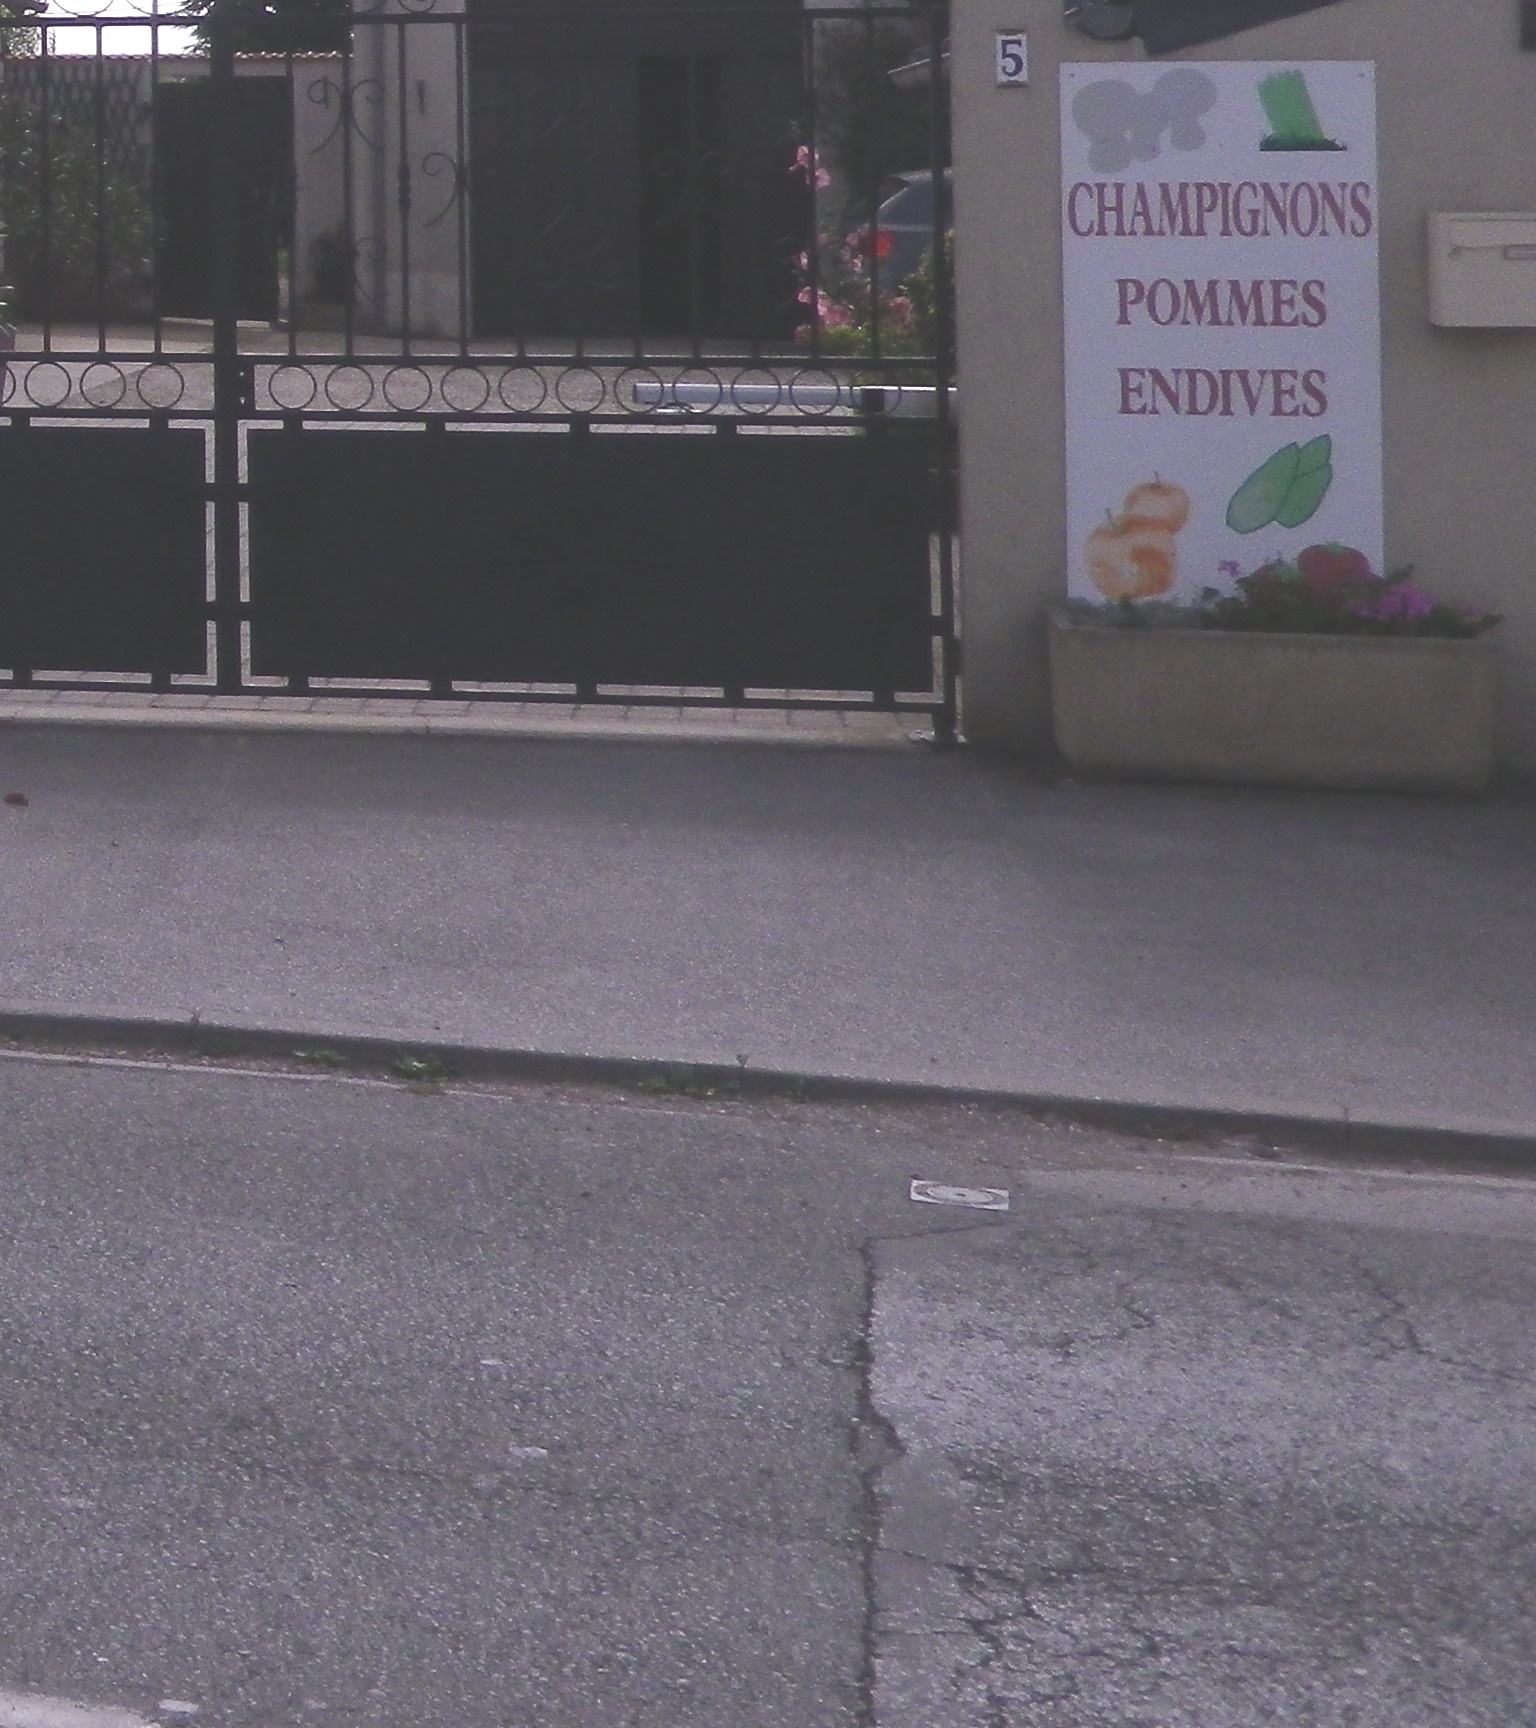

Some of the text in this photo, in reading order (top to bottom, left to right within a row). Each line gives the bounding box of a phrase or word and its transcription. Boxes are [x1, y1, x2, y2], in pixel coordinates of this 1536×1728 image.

[1000, 38, 1024, 77] 5
[1066, 180, 1373, 240] CHAMPIGNONS
[1114, 277, 1327, 327] POMMES
[1116, 366, 1329, 418] ENDIVES
